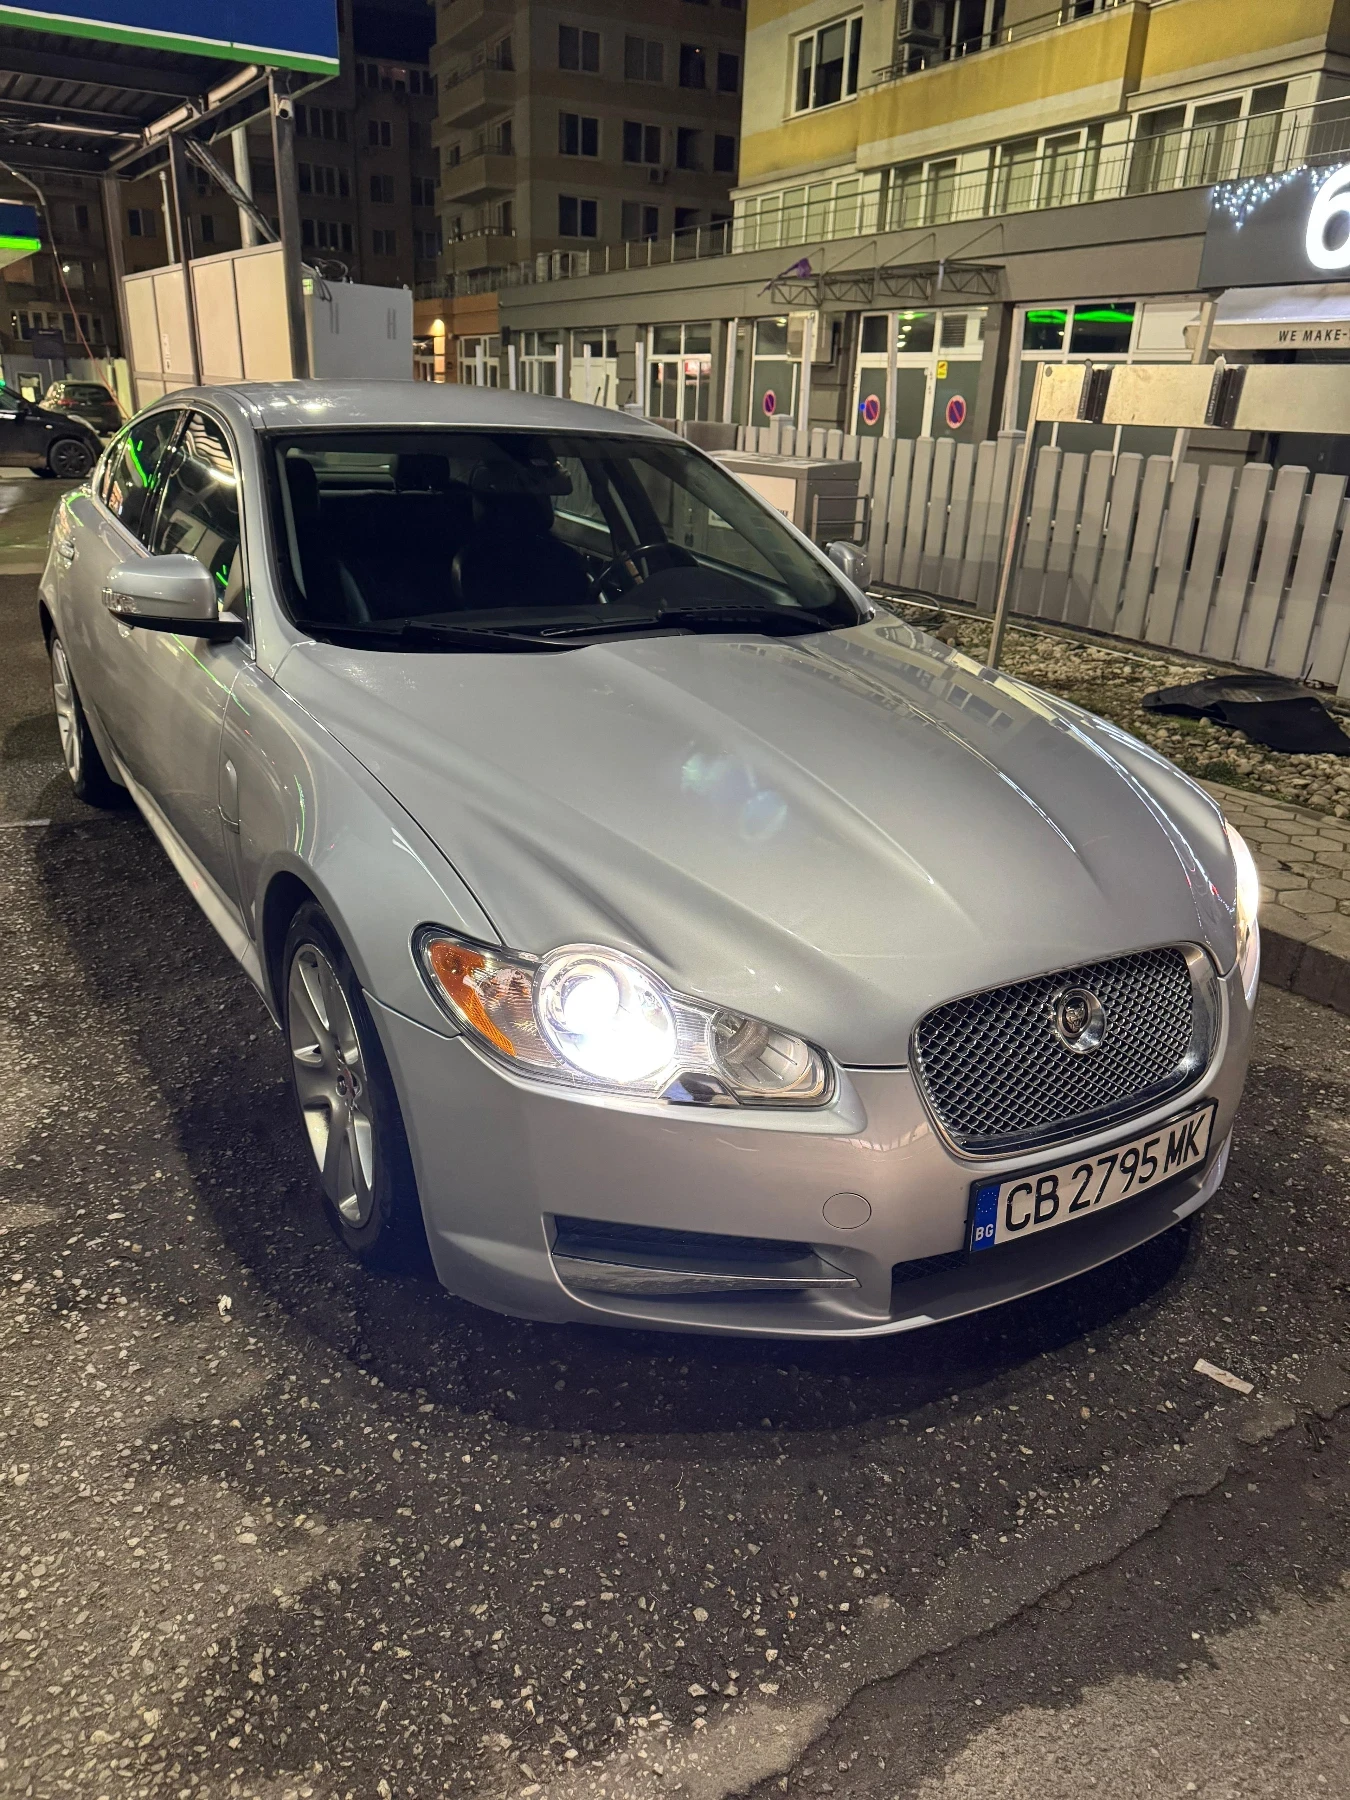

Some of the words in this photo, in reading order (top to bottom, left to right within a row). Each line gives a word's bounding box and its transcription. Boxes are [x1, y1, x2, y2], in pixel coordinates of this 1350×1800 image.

[1279, 330, 1297, 342] WE
[1303, 329, 1350, 342] MAKE-
[1005, 1174, 1060, 1232] CB
[1068, 1137, 1161, 1214] 2795
[1163, 1113, 1206, 1174] MK
[975, 1223, 994, 1242] BG
